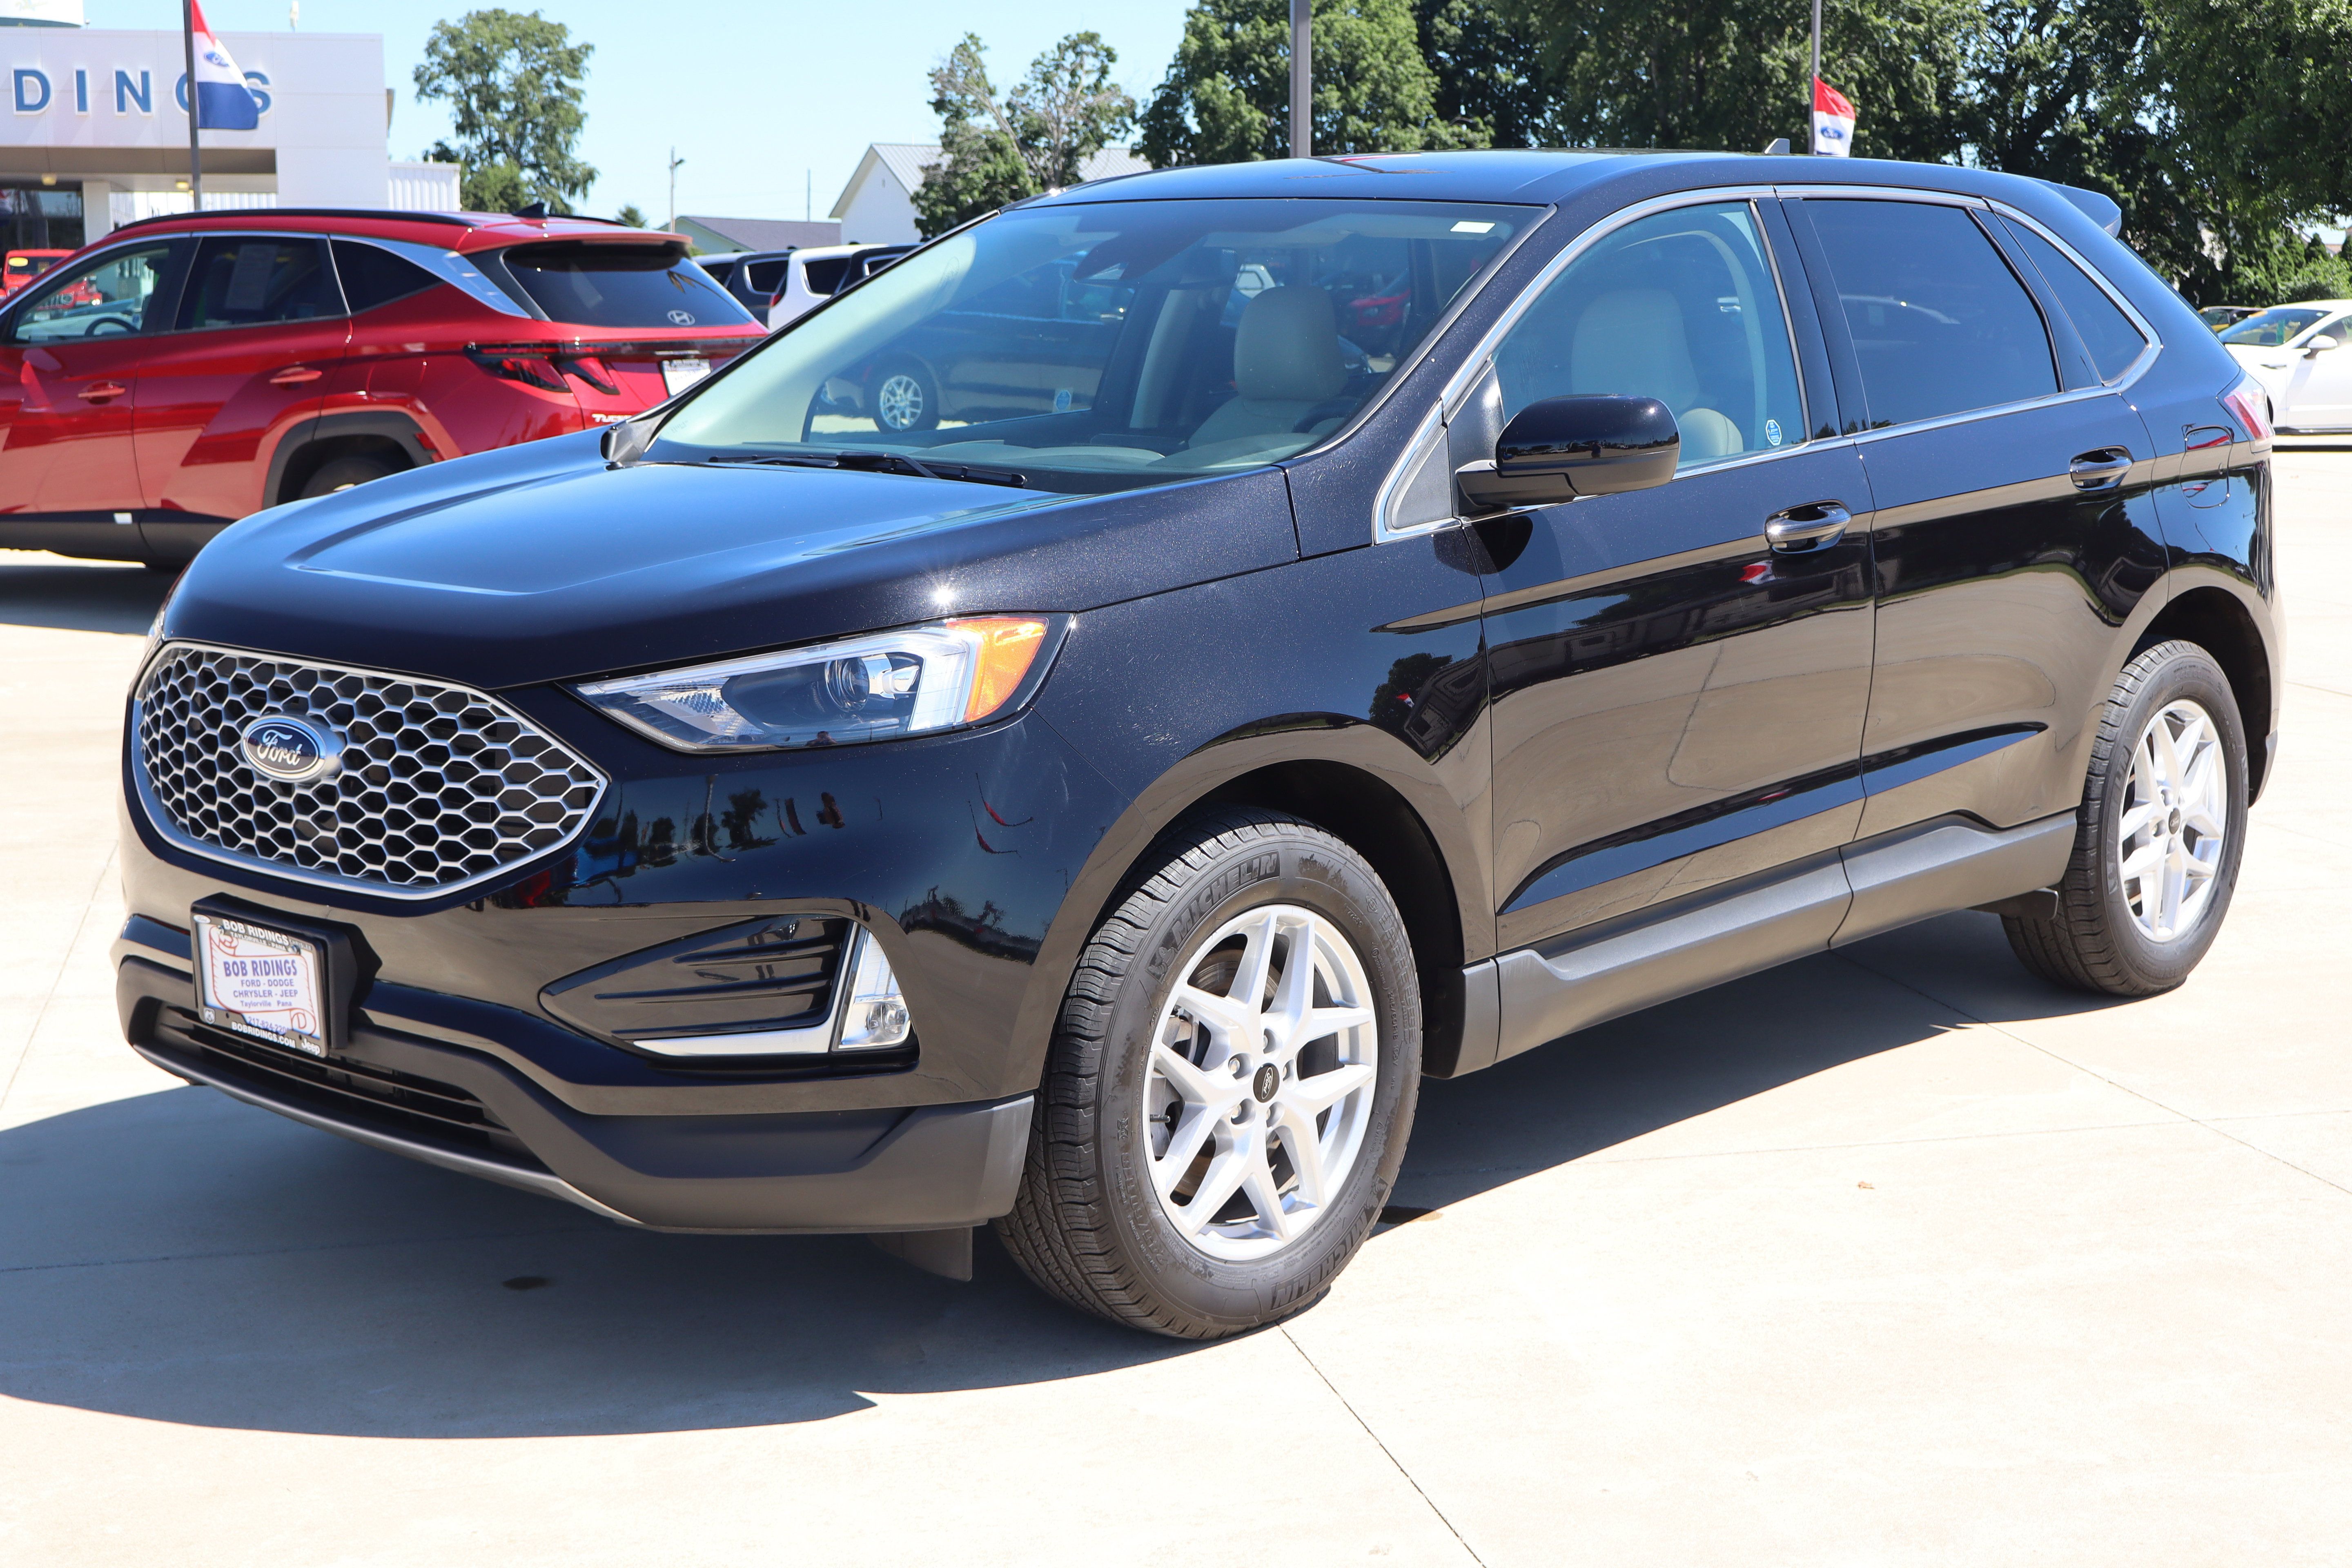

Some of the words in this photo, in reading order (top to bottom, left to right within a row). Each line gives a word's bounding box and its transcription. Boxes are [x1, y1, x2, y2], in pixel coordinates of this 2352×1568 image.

[257, 729, 302, 766] Ford
[1172, 853, 1278, 948] MICHELIN
[223, 919, 245, 933] BOB
[248, 926, 290, 946] RIDINGS
[223, 960, 247, 976] BOB
[251, 959, 297, 976] RIDINGS
[233, 989, 273, 998] CHRYSLER
[280, 989, 298, 997] JEEP
[241, 979, 261, 987] FORD
[267, 978, 294, 987] DODGE
[240, 1000, 272, 1008] Taylorville
[231, 1021, 296, 1049] BOBRIDINGS.COM
[301, 1038, 321, 1056] Jeep
[1263, 1072, 1272, 1094] Ford
[1276, 1206, 1369, 1306] MICHELIN
